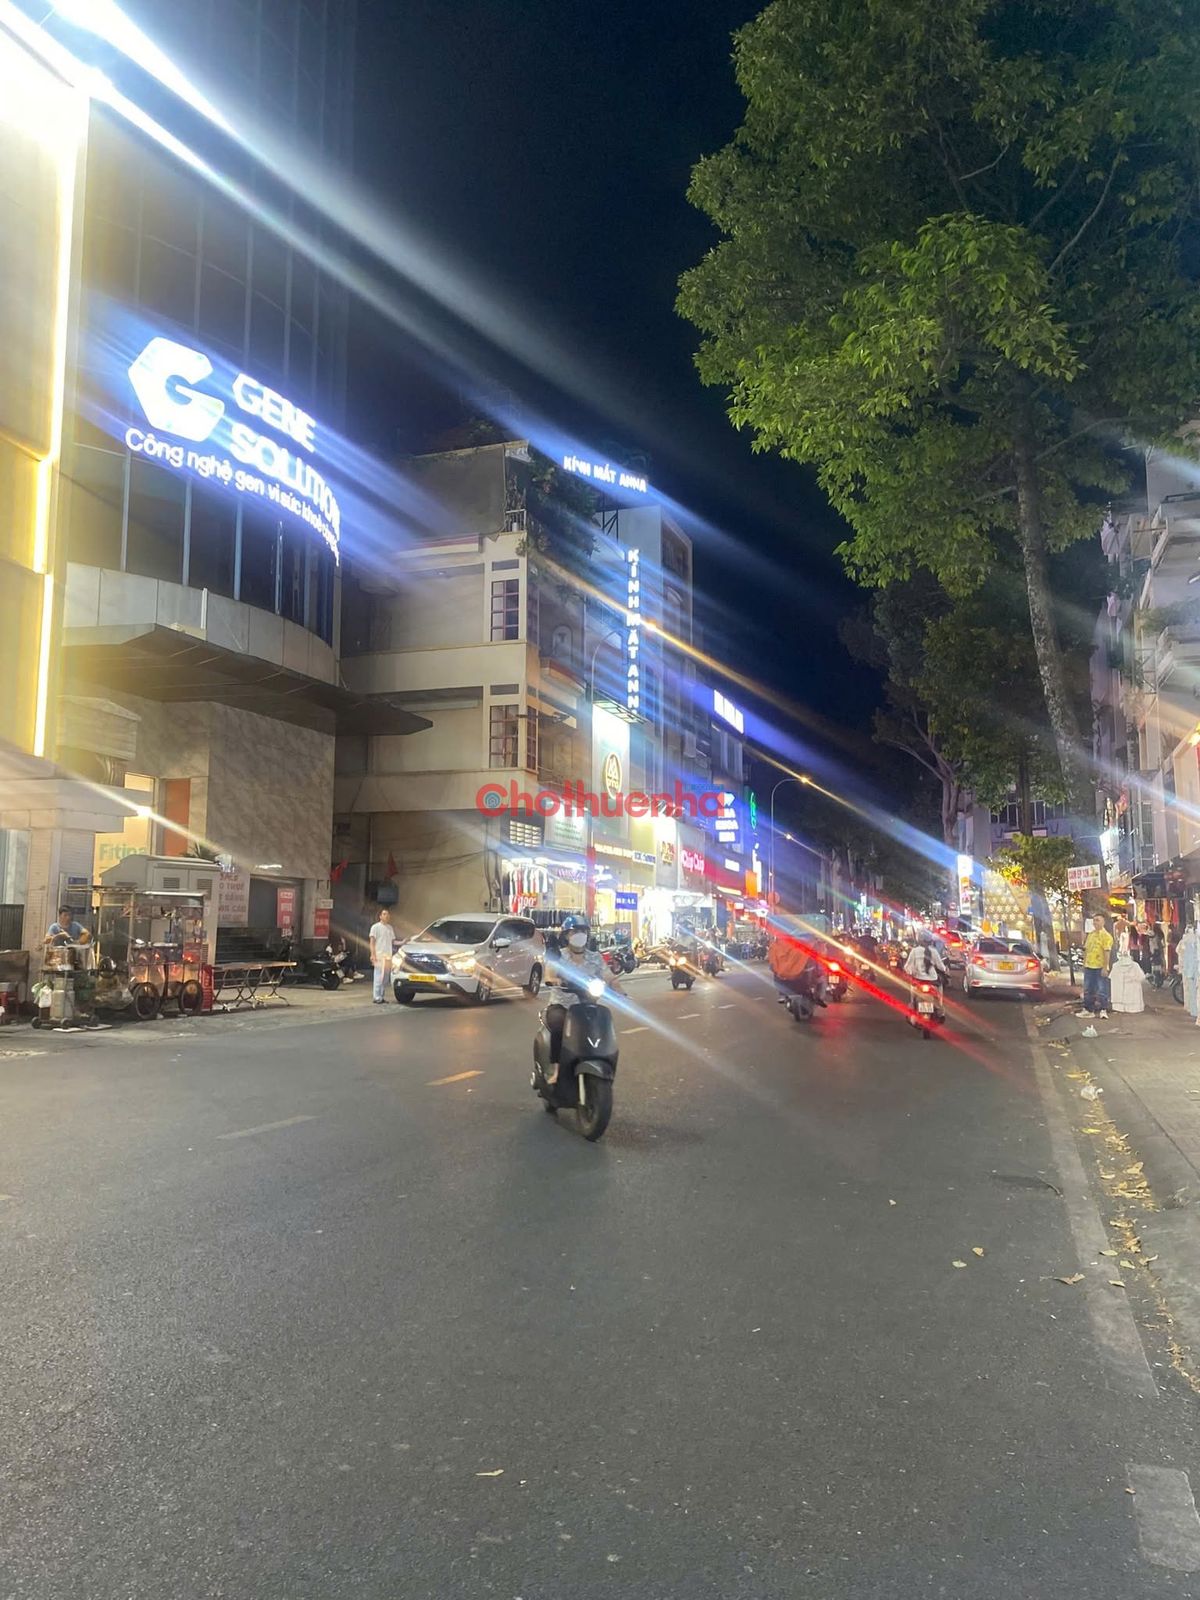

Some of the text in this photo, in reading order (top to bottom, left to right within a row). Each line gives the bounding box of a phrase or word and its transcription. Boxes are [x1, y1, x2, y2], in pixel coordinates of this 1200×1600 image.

[231, 373, 316, 452] GENE
[125, 428, 184, 468] Công
[187, 450, 233, 487] nghệ
[235, 470, 264, 495] gen
[563, 455, 591, 476] KÍNH
[619, 473, 647, 493] ANNA
[628, 549, 640, 608] KÍNH
[627, 664, 640, 714] ANN
